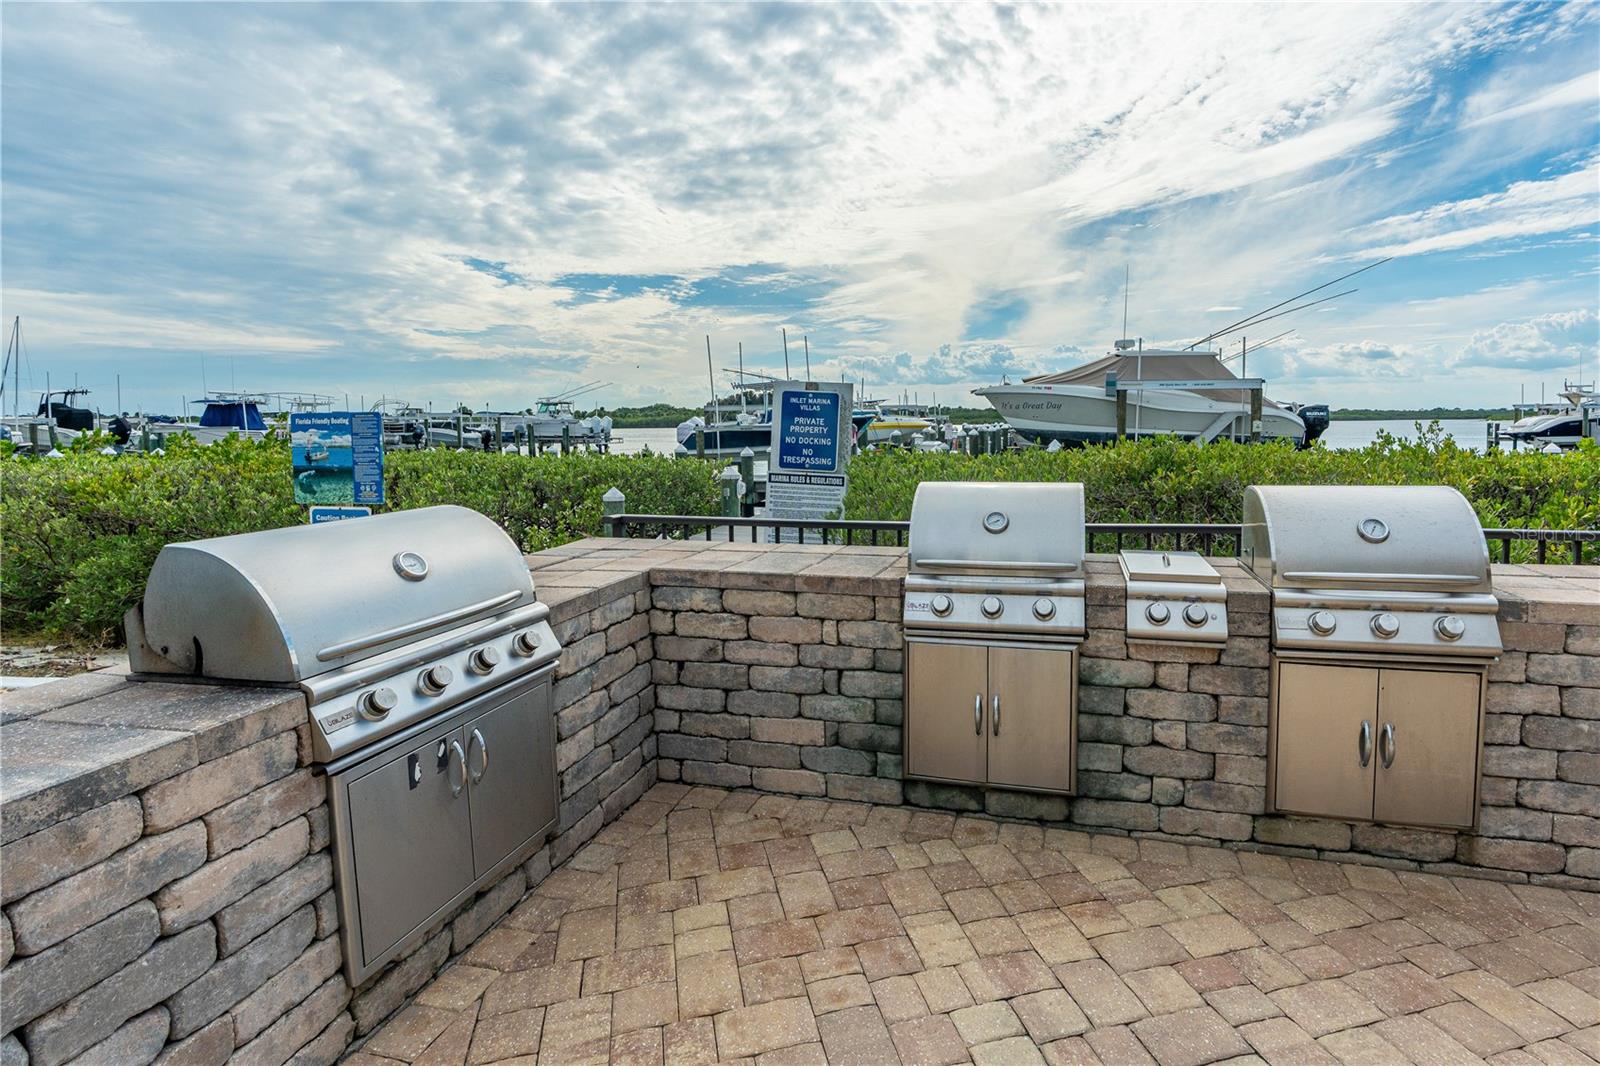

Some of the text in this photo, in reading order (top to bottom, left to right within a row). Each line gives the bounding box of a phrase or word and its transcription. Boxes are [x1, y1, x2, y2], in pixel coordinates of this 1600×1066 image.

[1002, 402, 1012, 410] It's
[1022, 402, 1044, 410] Great
[1046, 402, 1062, 411] Day
[794, 417, 825, 426] PRIVATE
[790, 426, 828, 434] PROPERTY
[799, 437, 832, 445] DOCKING
[783, 456, 832, 465] TRESPASSING
[811, 477, 843, 485] REGULATIONS
